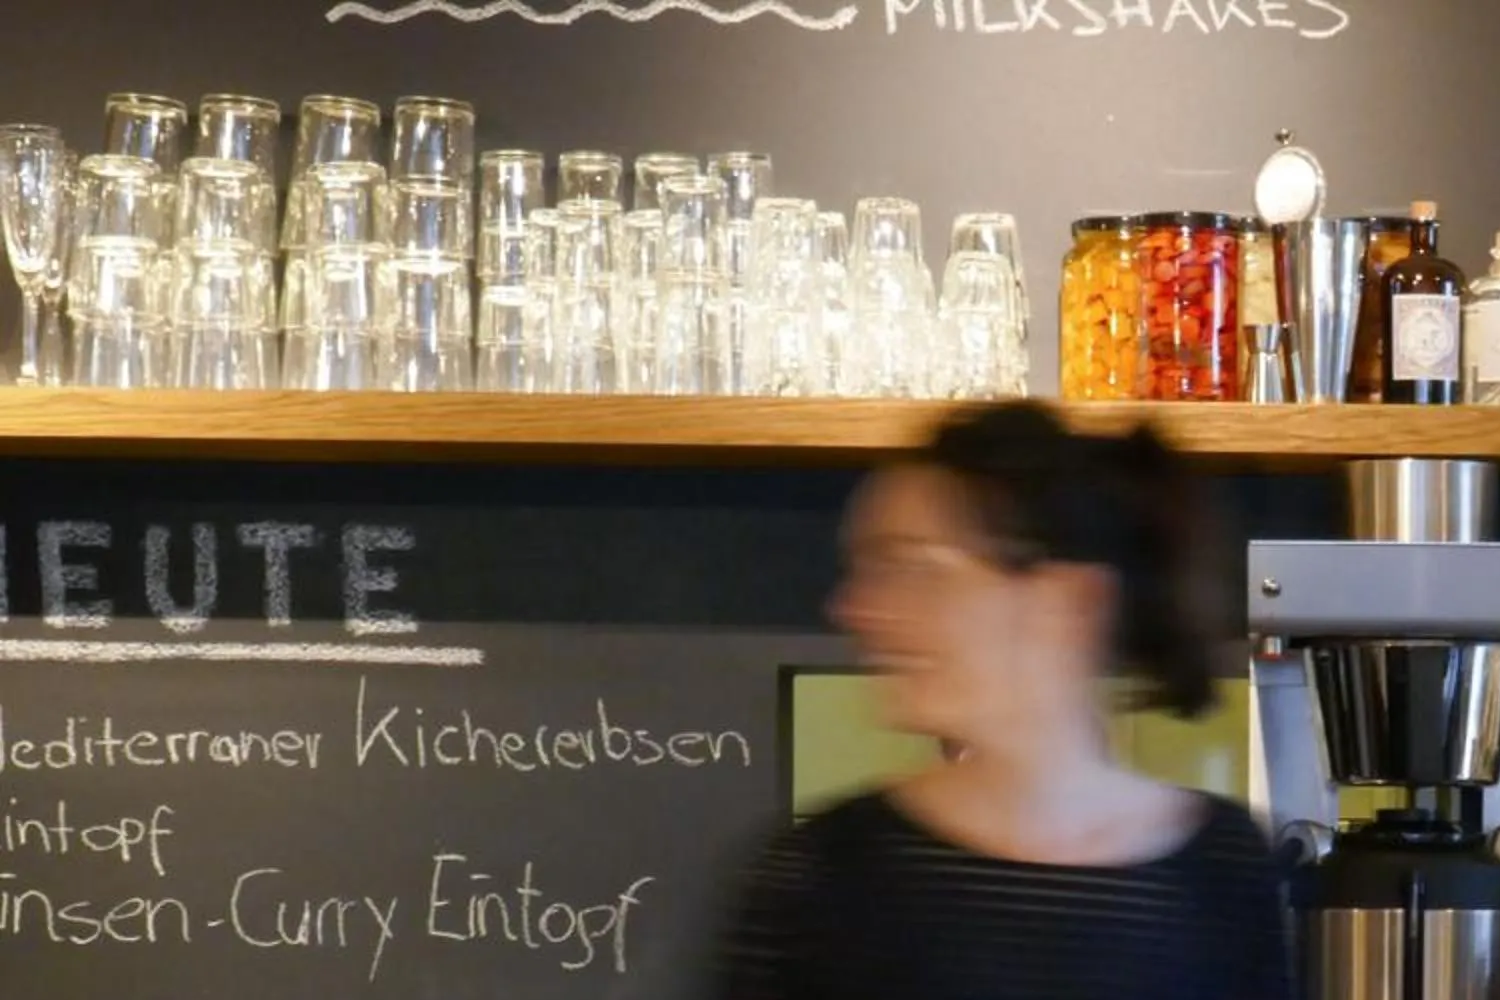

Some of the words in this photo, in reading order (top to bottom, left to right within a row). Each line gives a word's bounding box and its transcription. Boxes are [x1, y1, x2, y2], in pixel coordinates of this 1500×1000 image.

[885, 0, 1349, 38] MILKSHAKES
[0, 704, 321, 769] editerraner
[355, 676, 751, 771] Kichererbsen
[0, 797, 174, 876] intopf
[0, 868, 399, 982] insen-Curry
[428, 854, 655, 973] Eintopf
